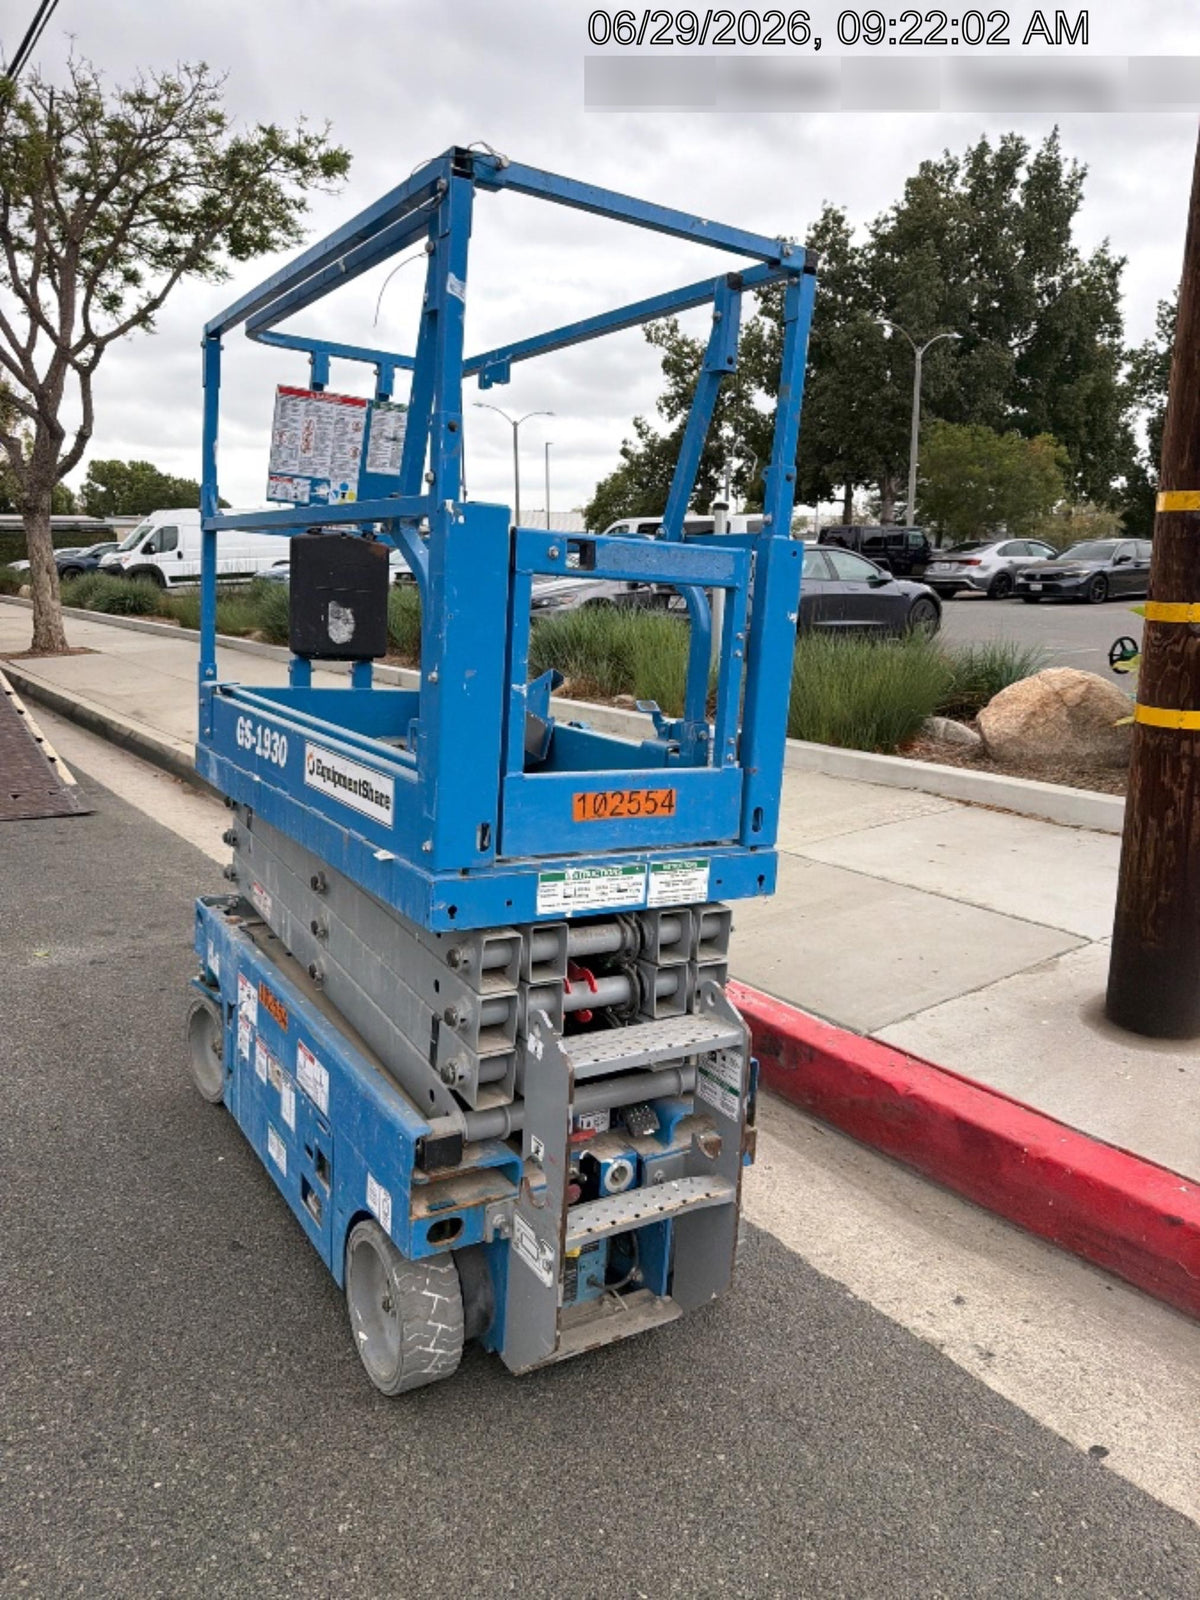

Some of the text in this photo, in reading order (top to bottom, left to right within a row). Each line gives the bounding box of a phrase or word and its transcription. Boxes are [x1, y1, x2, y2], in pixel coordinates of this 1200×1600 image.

[236, 716, 288, 768] GS-1930
[316, 758, 391, 811] EquipmentShare
[577, 789, 675, 818] 102554
